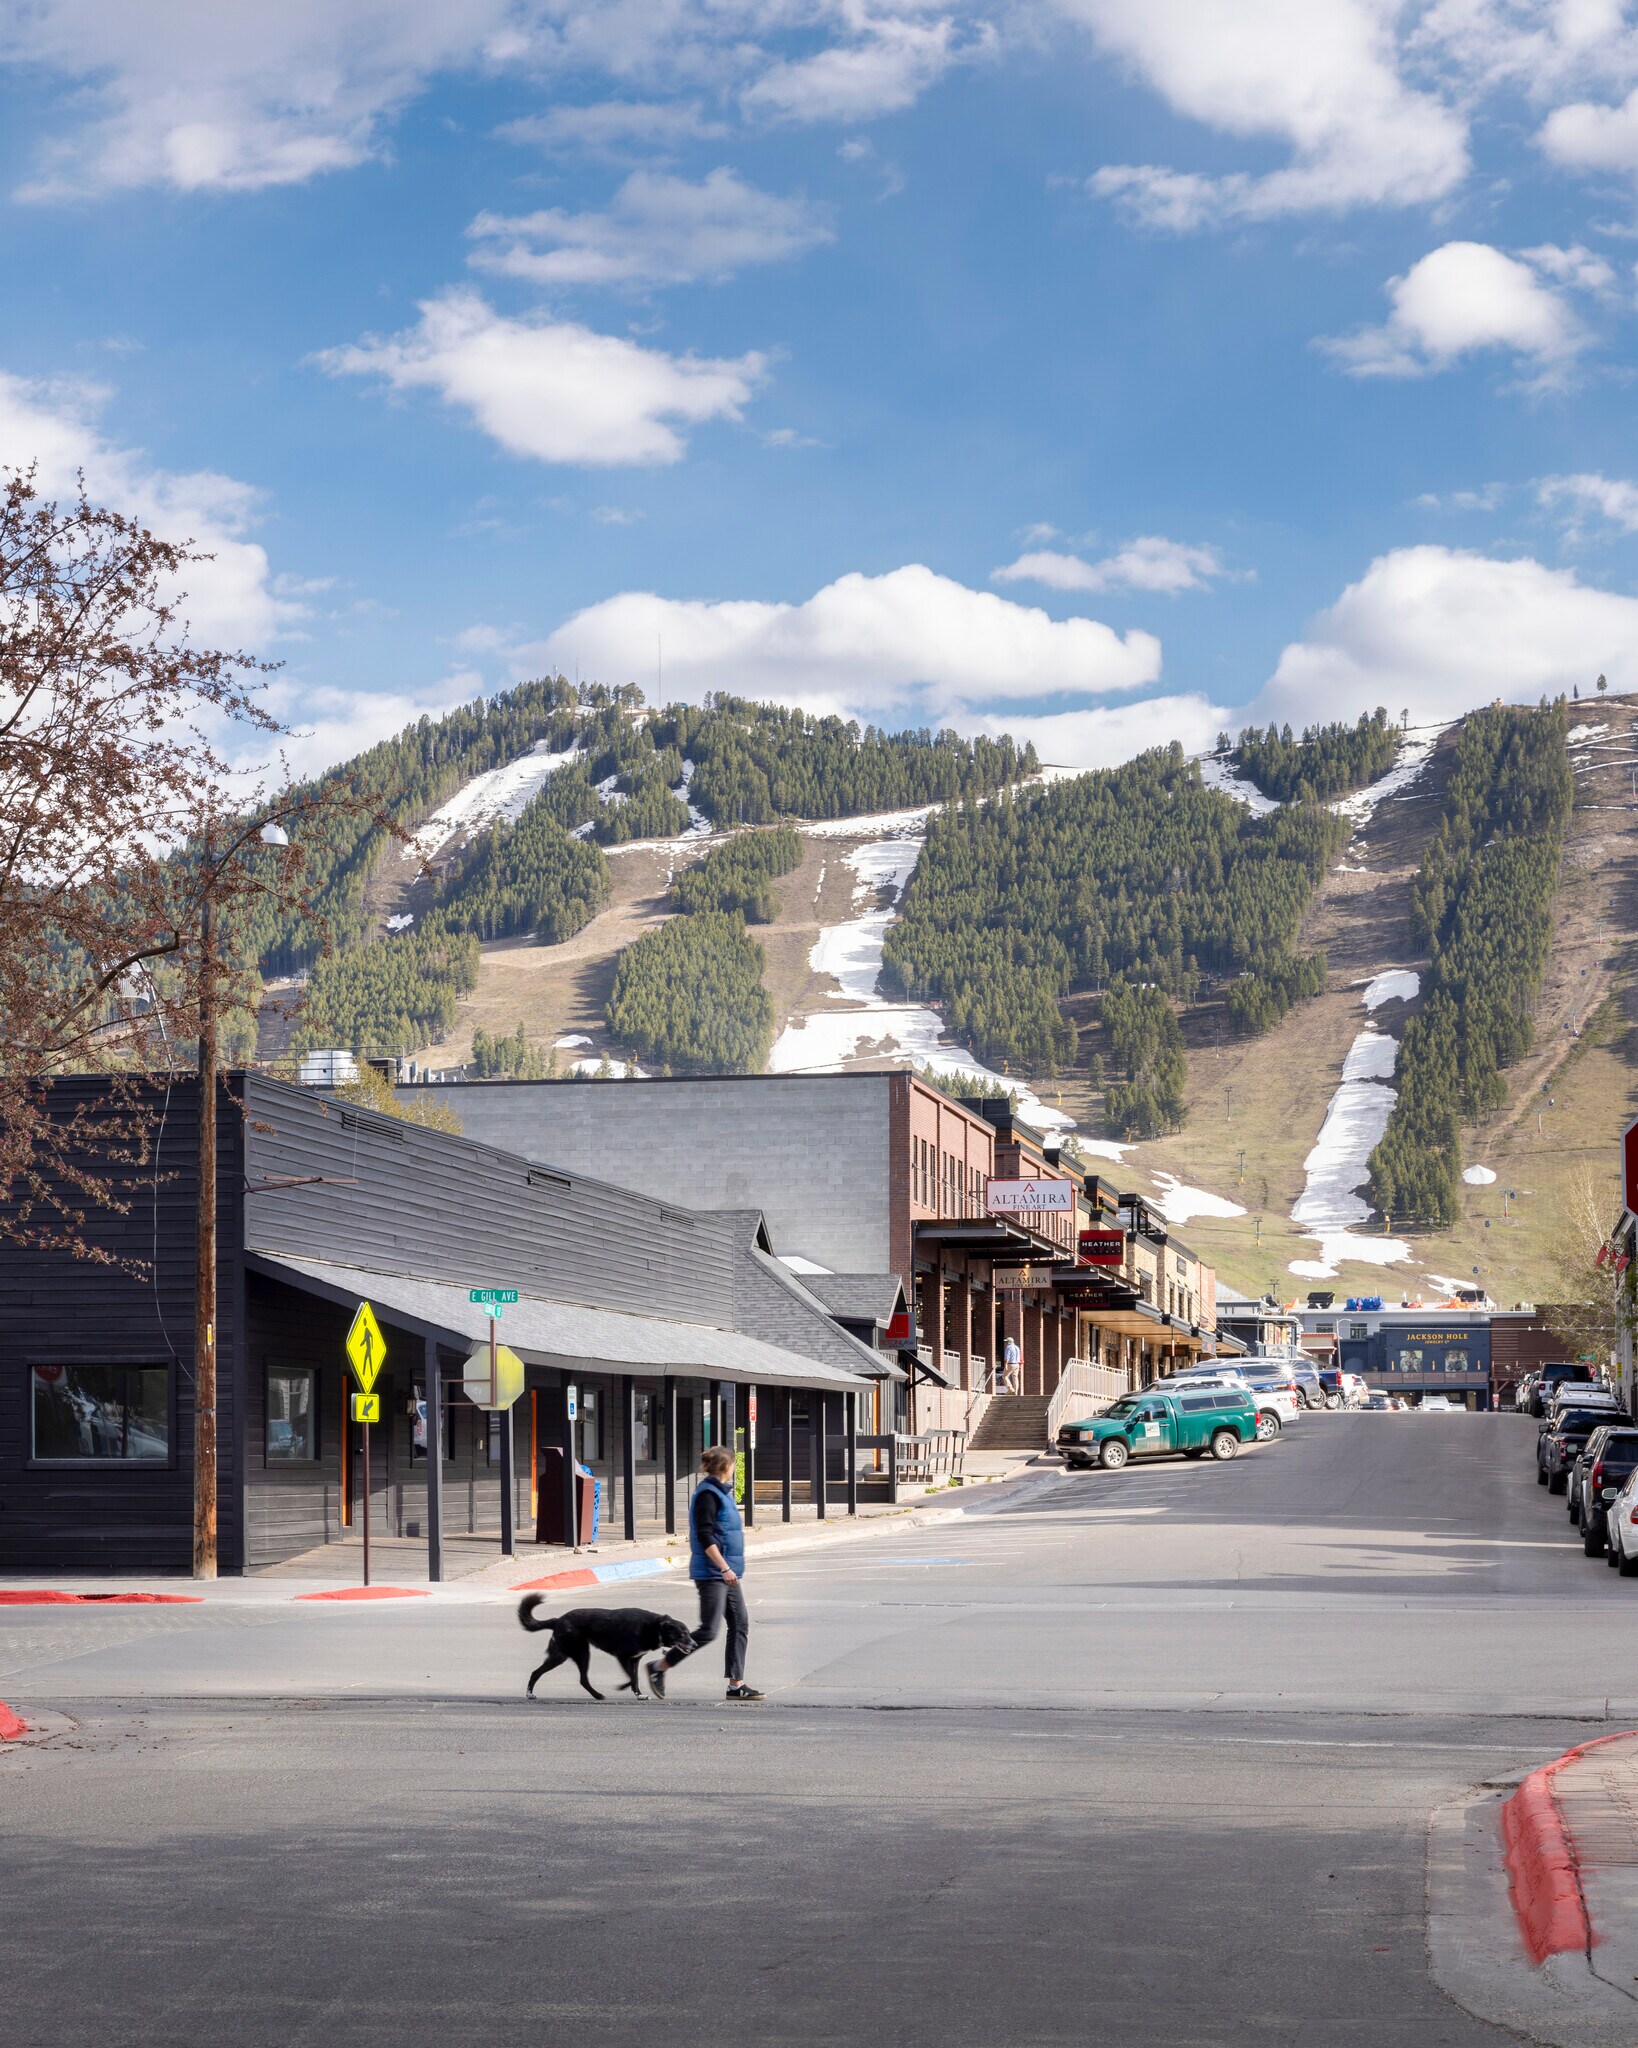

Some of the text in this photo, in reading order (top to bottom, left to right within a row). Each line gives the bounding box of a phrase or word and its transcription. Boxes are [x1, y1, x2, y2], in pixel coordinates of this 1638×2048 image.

[992, 1194, 1067, 1204] ALTAMIRA
[998, 1276, 1047, 1284] ALTAMIRA
[471, 1291, 516, 1301] E GILL AVE
